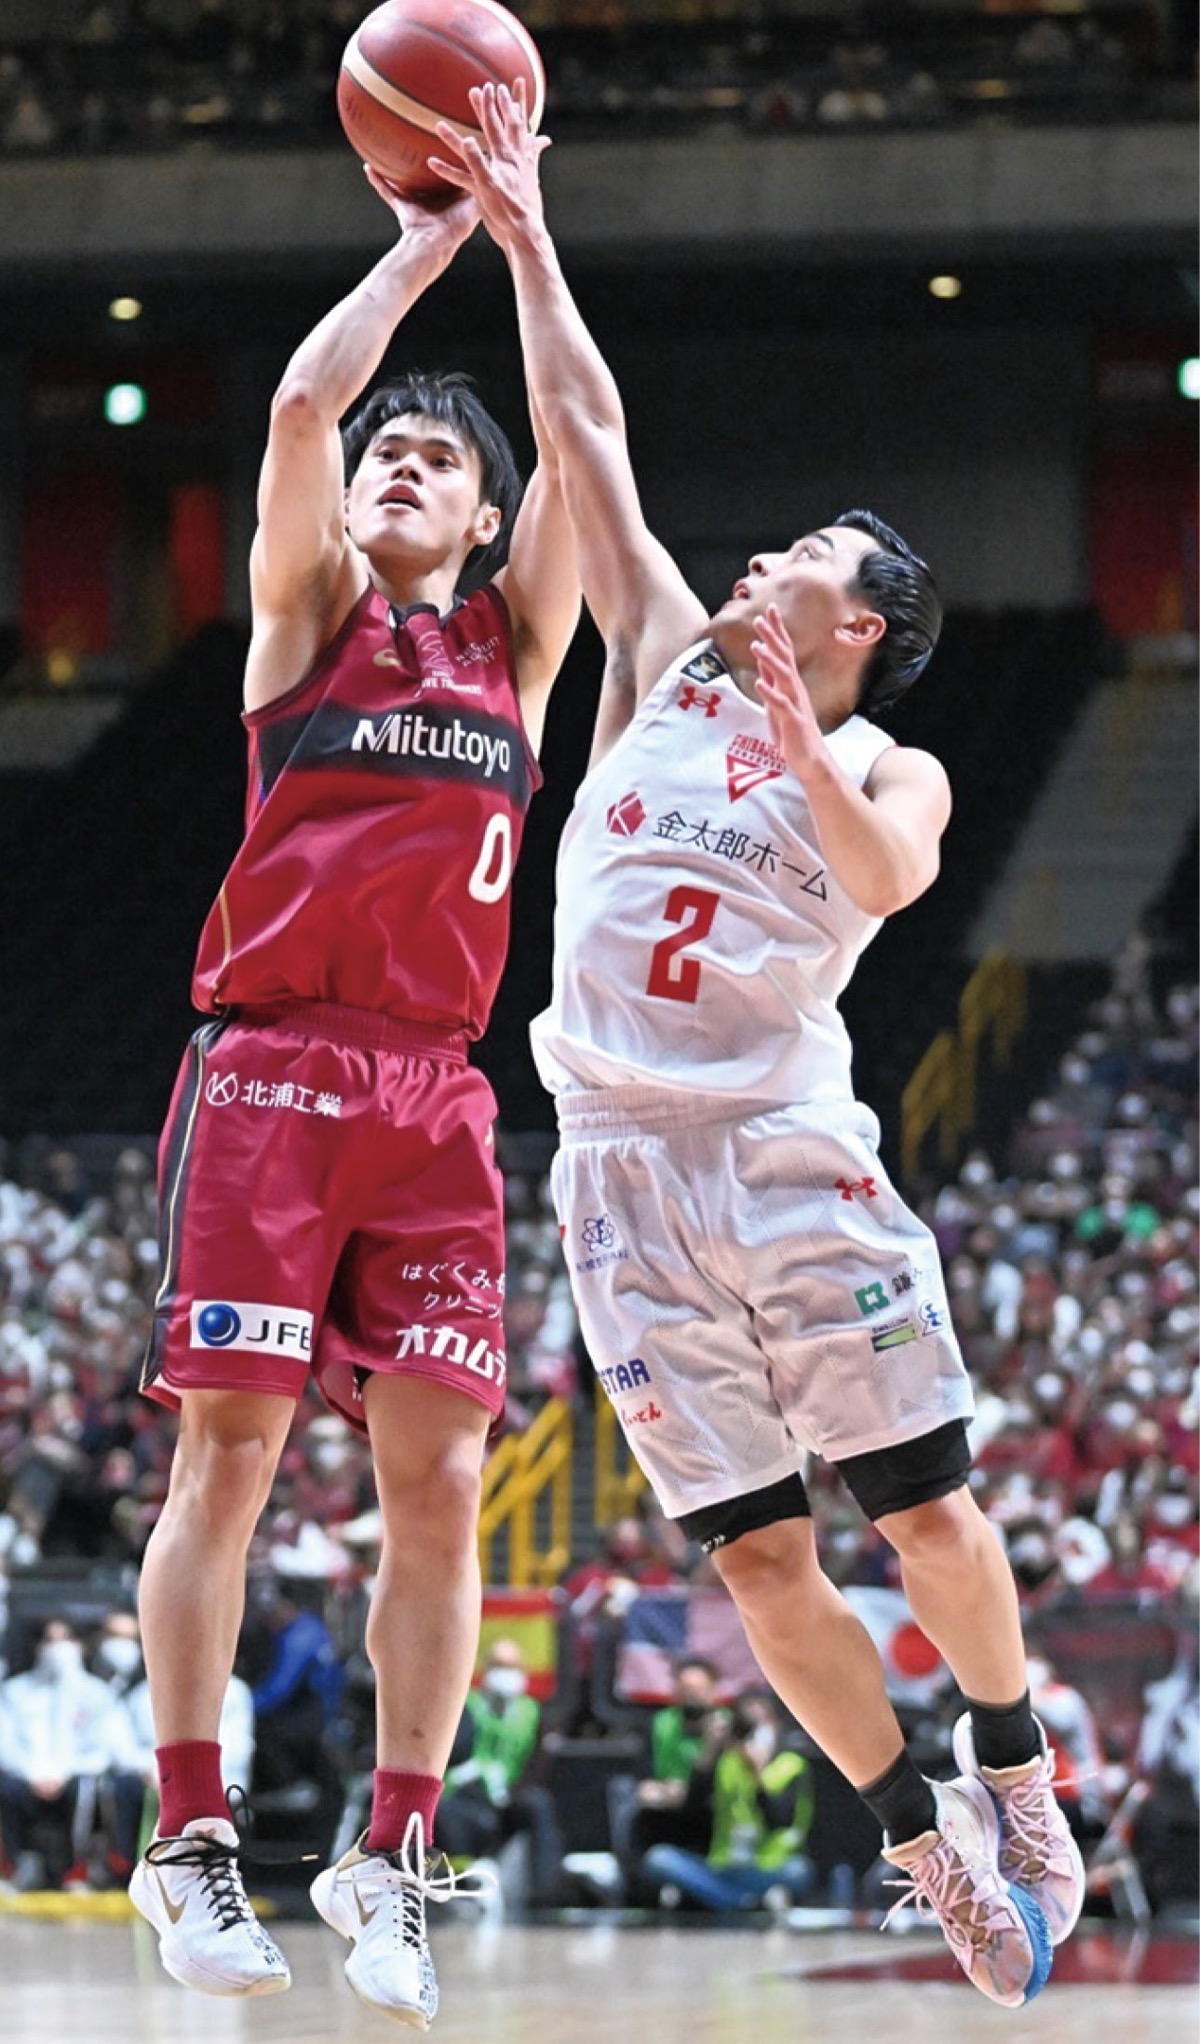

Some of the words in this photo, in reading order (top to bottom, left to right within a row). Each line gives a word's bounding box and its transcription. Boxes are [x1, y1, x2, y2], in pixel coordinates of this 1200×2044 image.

[352, 714, 511, 778] Mitutoyo
[468, 812, 511, 904] 0
[652, 810, 828, 901] 金太郎ホーム
[646, 885, 720, 1004] 2
[241, 1080, 343, 1119] 北浦工業
[246, 1319, 310, 1352] JFE
[424, 1292, 503, 1328] クリニッ
